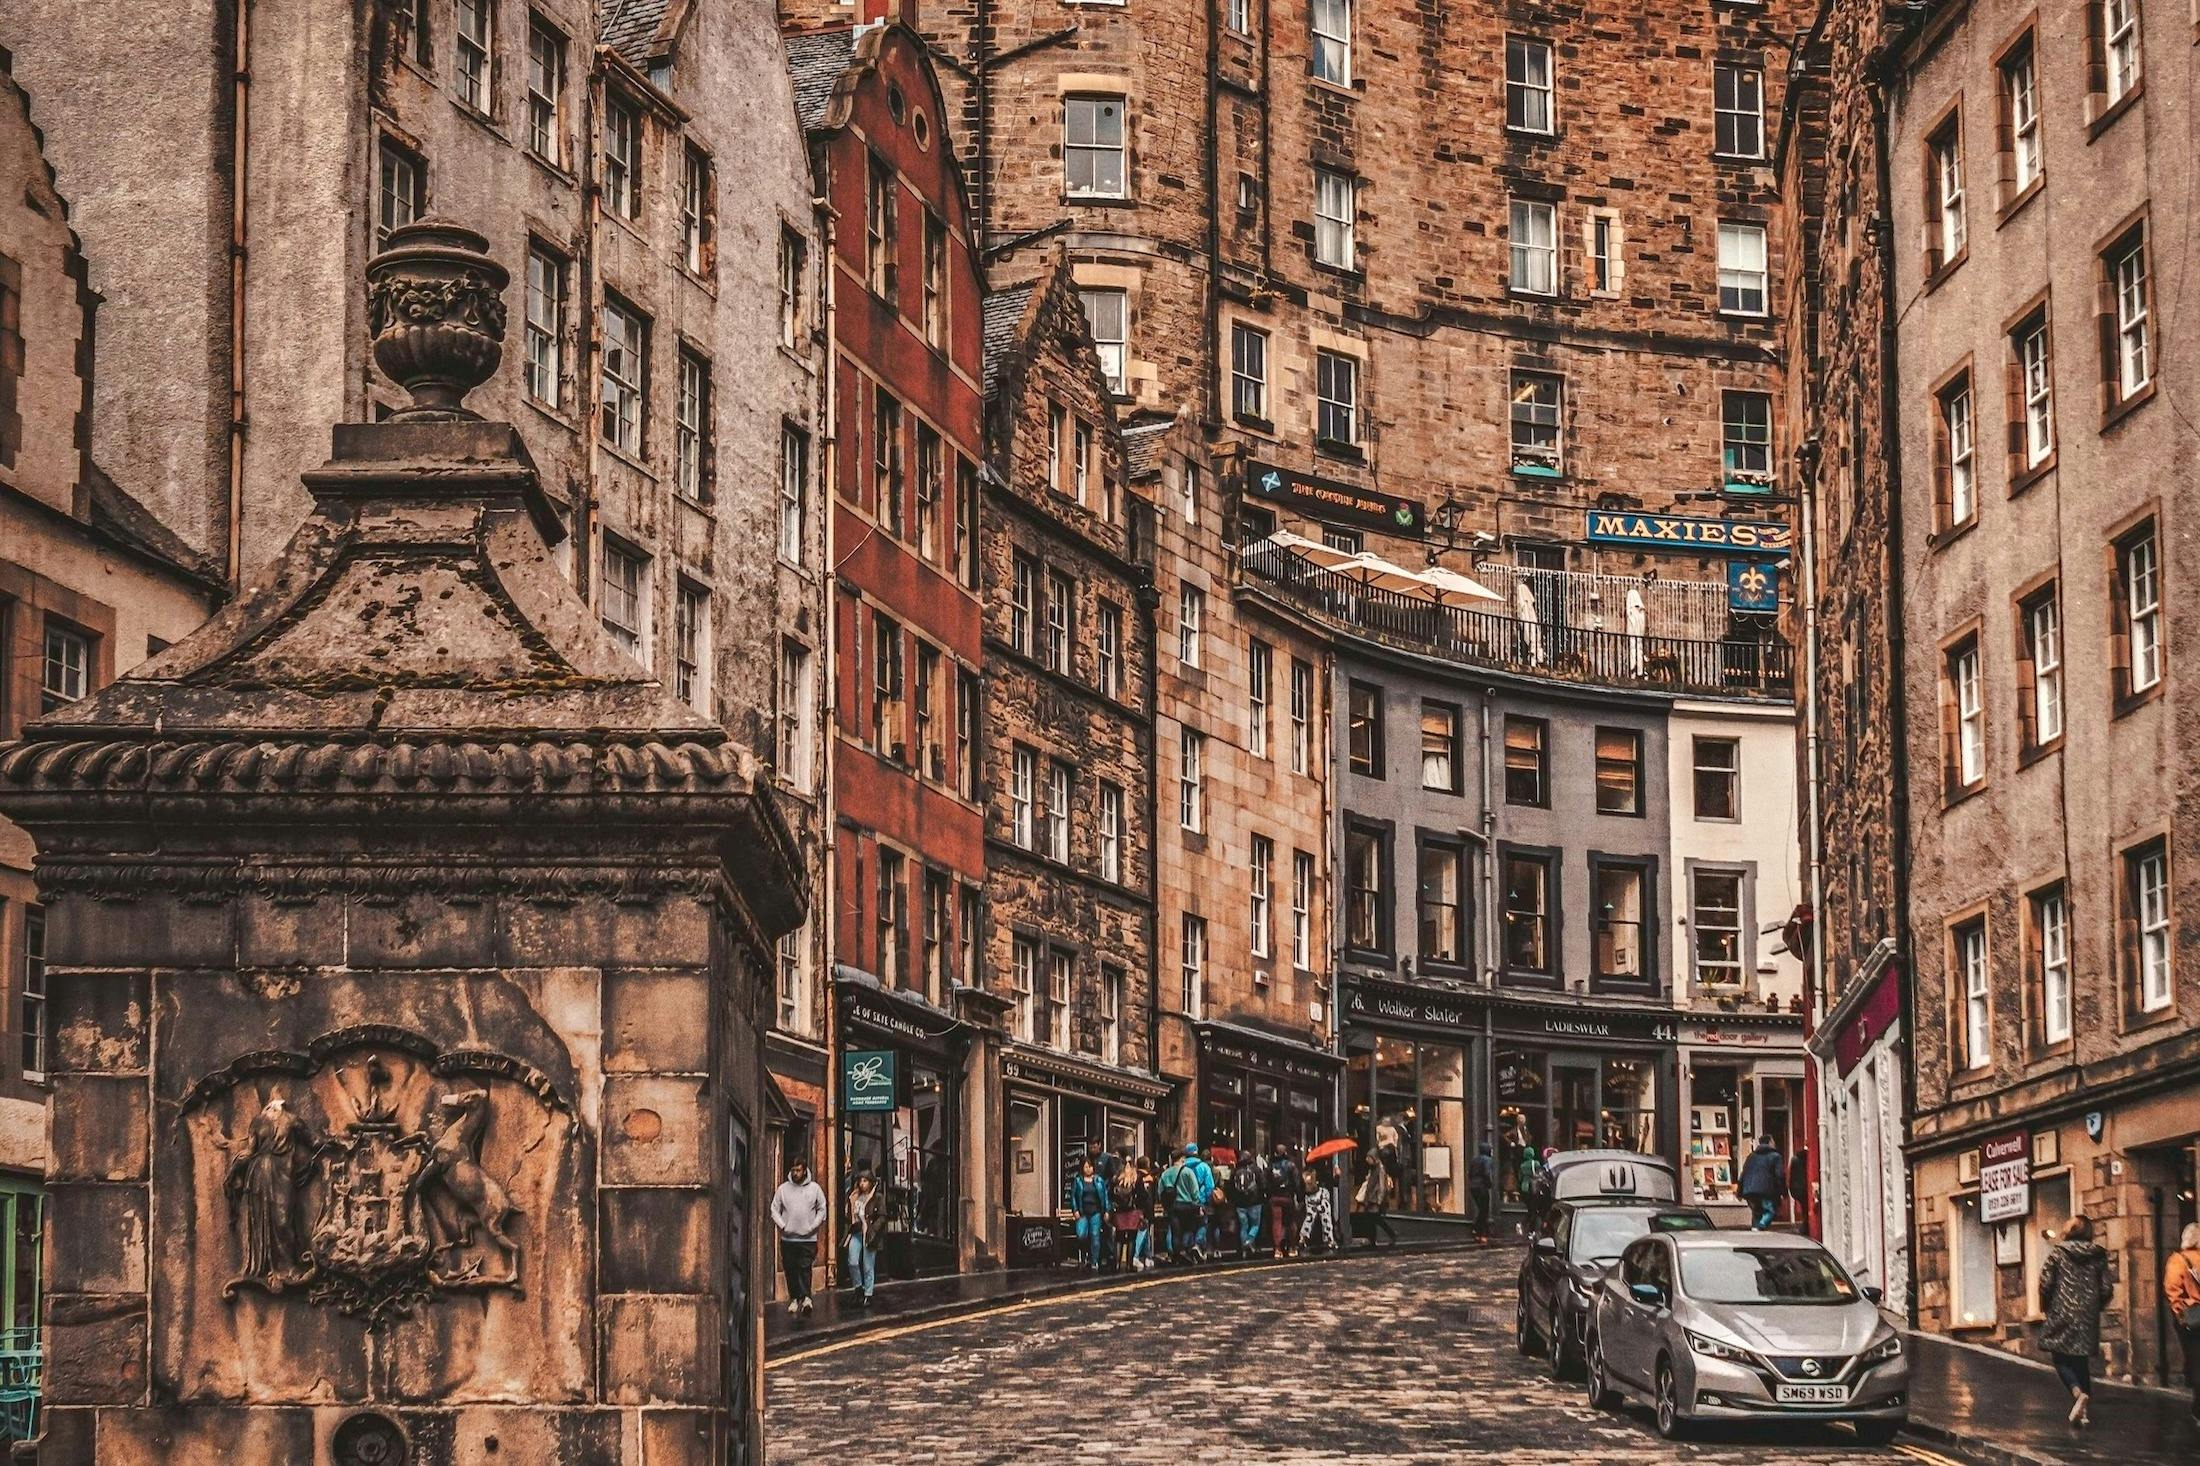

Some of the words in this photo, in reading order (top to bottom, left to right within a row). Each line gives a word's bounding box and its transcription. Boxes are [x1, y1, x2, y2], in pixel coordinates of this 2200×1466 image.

[1595, 516, 1757, 545] MAXIES
[862, 1008, 871, 1020] OF
[873, 1011, 888, 1026] SKYE
[890, 1018, 914, 1035] CANDLE
[1378, 1000, 1417, 1019] Walker
[1425, 1006, 1462, 1024] Slater
[1545, 1020, 1609, 1036] LADIESWEAR
[1720, 1031, 1738, 1040] door
[1741, 1032, 1768, 1044] gallery
[1006, 1062, 1020, 1077] 89
[1143, 1098, 1156, 1111] 89
[1986, 1136, 2022, 1159] Culverwell
[1982, 1169, 1999, 1193] LEASE
[2000, 1166, 2012, 1190] FOR
[2012, 1162, 2029, 1187] SALE
[1783, 1388, 1815, 1399] SM69
